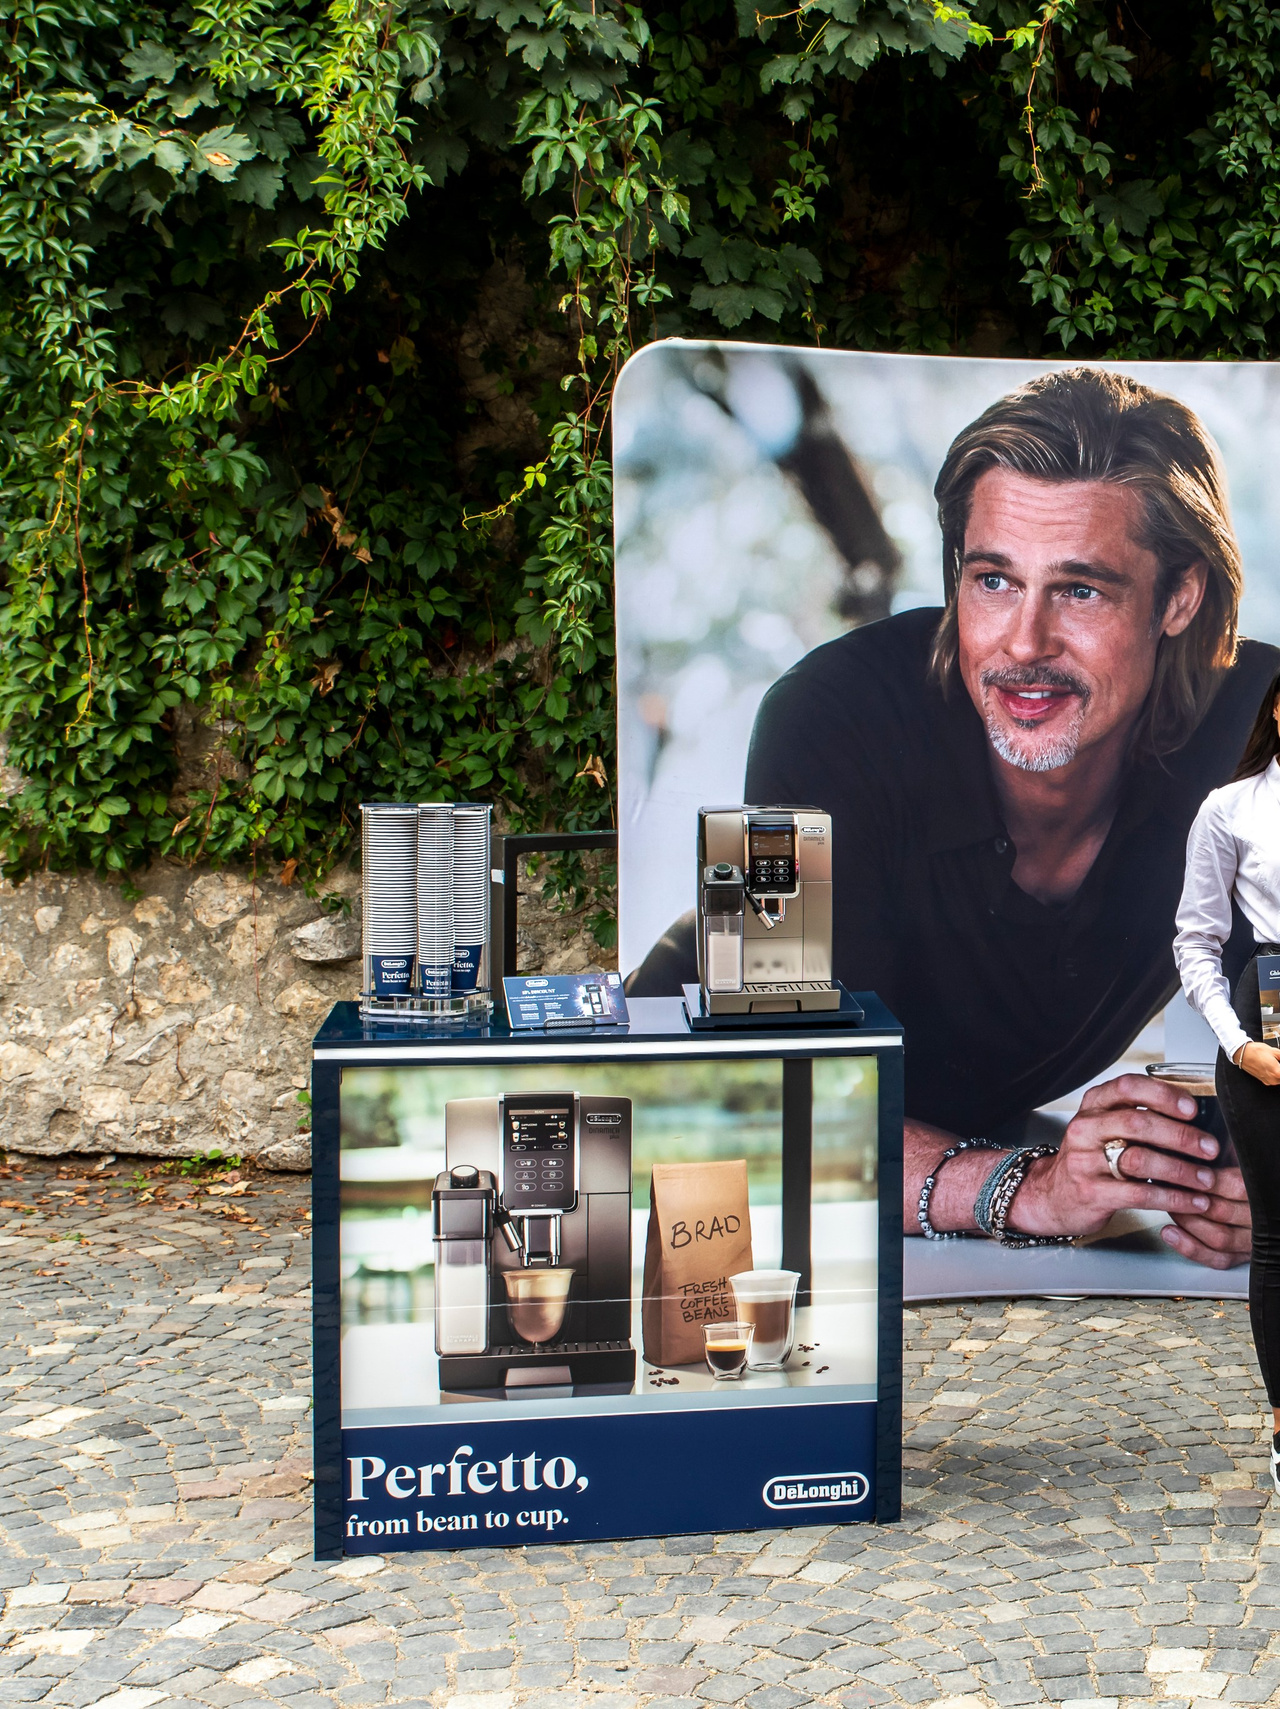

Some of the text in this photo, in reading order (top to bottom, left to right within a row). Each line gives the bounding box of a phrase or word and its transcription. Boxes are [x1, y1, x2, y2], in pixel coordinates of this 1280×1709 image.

[670, 1214, 741, 1250] BRAD
[678, 1276, 728, 1296] FRESH
[680, 1292, 729, 1310] COFFEE
[682, 1306, 730, 1323] BEANS
[346, 1445, 589, 1501] Perfetto,
[346, 1509, 570, 1537] from bean to cup.
